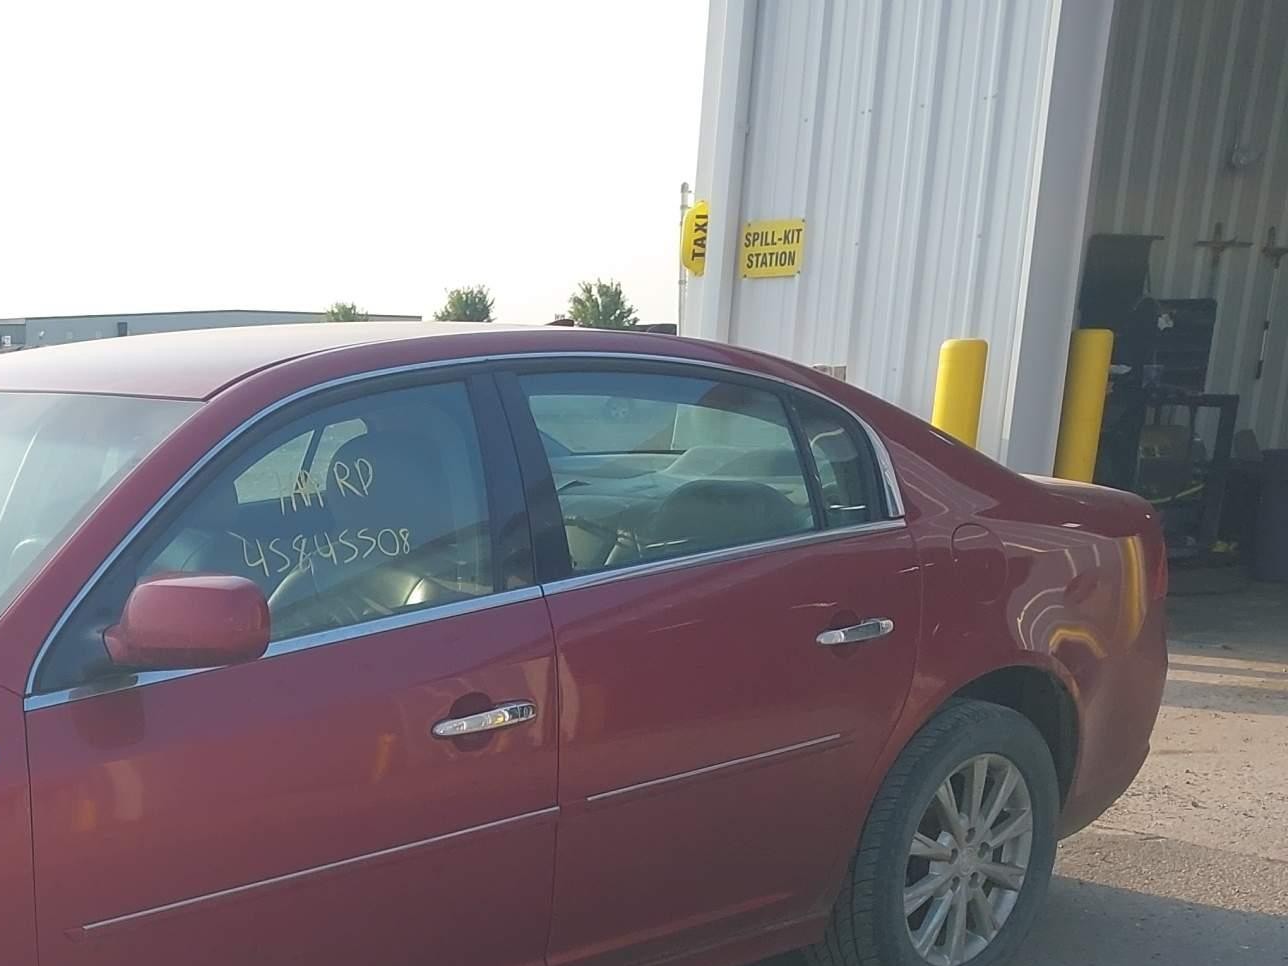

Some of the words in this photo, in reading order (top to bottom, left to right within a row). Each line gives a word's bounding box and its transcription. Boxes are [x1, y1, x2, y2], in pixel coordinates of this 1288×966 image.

[691, 214, 709, 262] TAXI
[744, 228, 803, 248] SPILL-KIT
[746, 250, 796, 269] STATION
[332, 457, 374, 498] RD
[227, 528, 411, 577] 45845508
